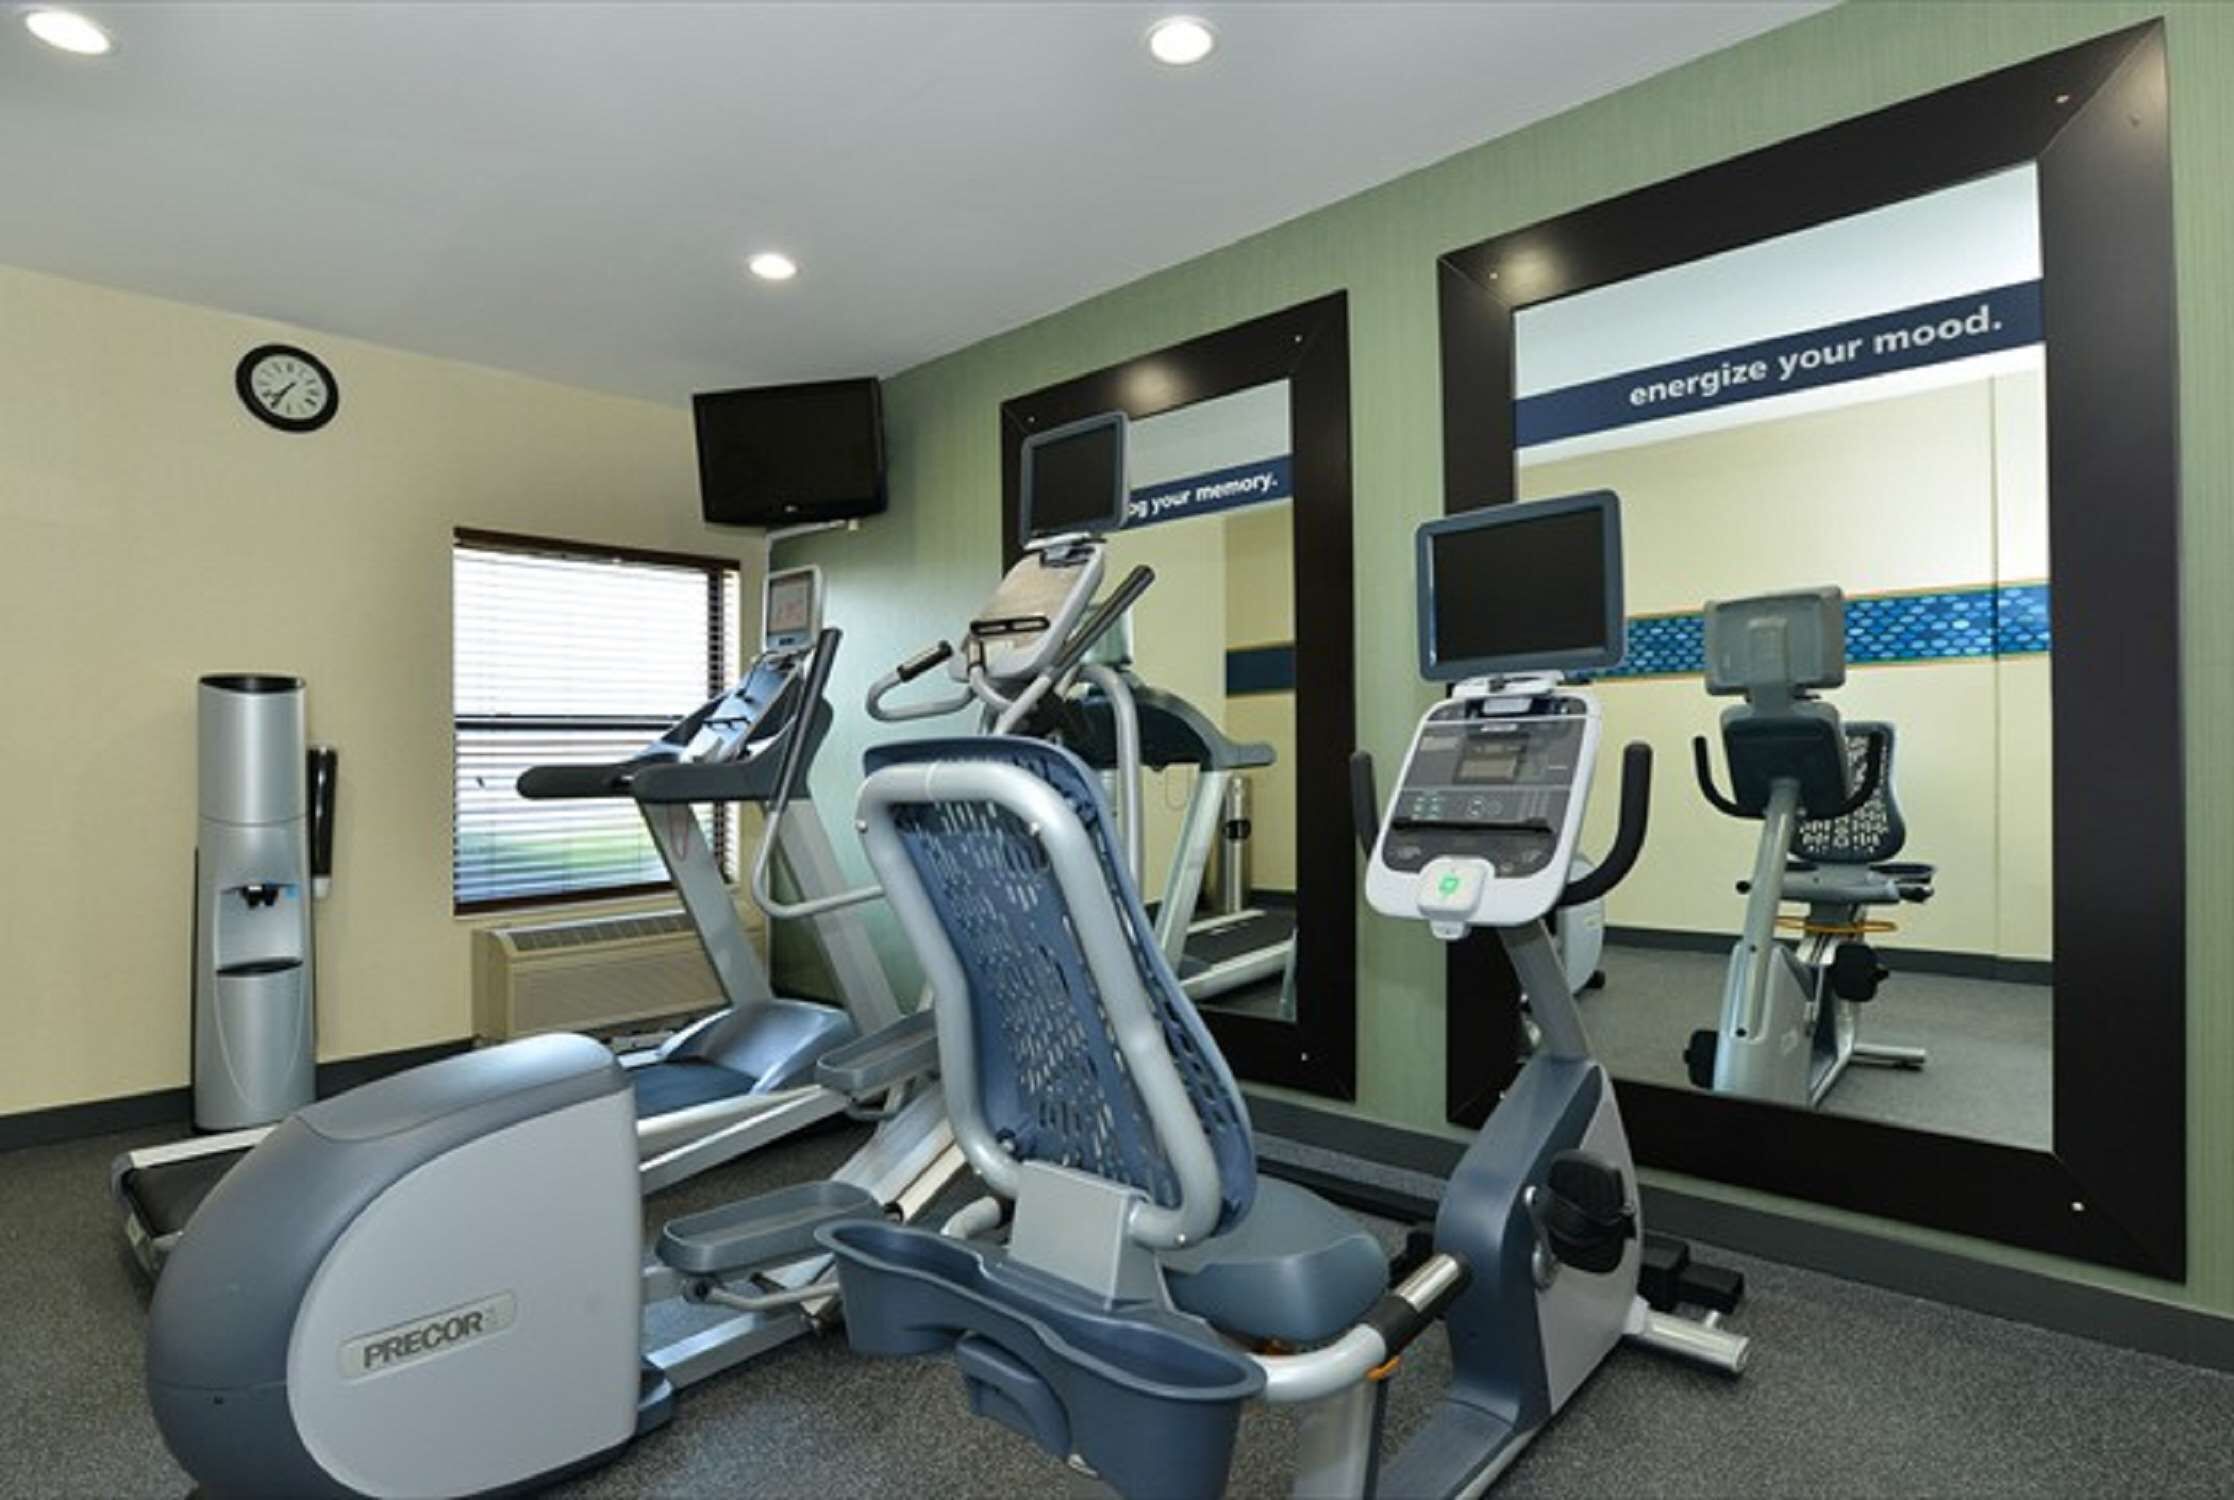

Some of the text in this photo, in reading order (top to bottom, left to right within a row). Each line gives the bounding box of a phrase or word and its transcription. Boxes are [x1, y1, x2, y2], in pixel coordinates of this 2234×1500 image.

[1629, 305, 2001, 406] energize your mood.
[1151, 489, 1190, 514] your
[1195, 472, 1278, 502] memory.
[364, 1311, 483, 1368] PRECOR
